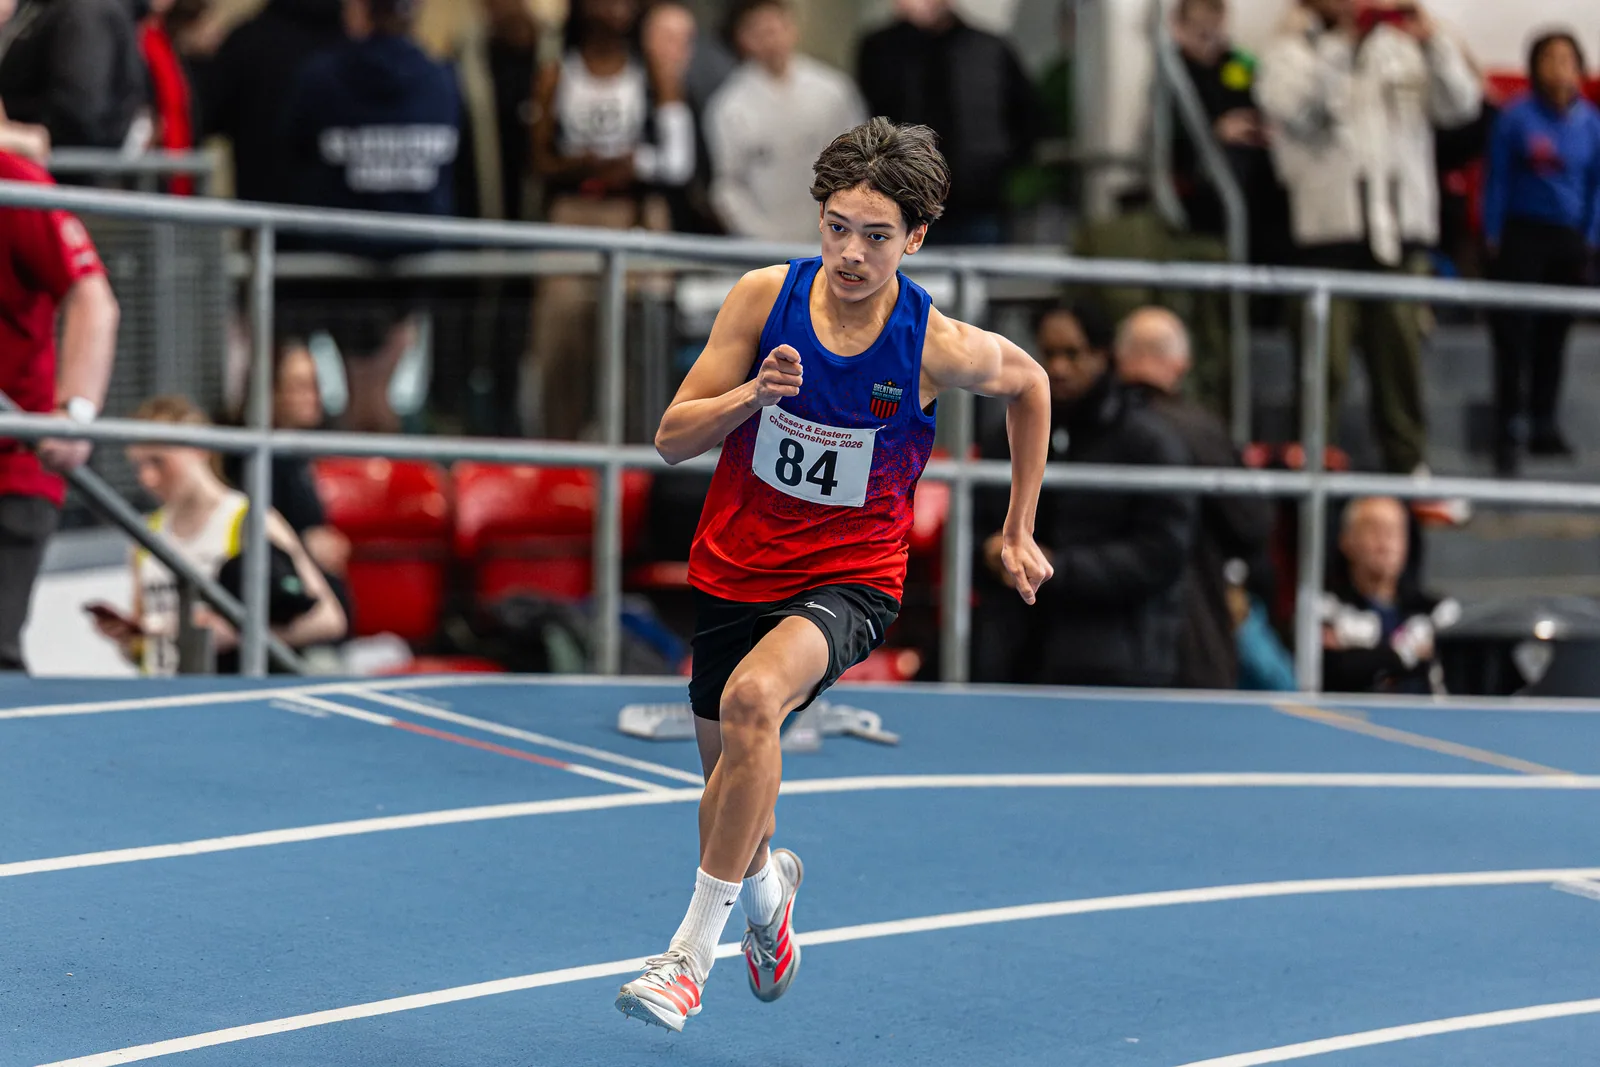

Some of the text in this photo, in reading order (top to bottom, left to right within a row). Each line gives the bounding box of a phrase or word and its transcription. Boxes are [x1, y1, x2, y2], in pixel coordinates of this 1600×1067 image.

[769, 415, 864, 449] Championships 2026
[778, 412, 852, 440] Essex & Eastern
[775, 437, 838, 496] 84
